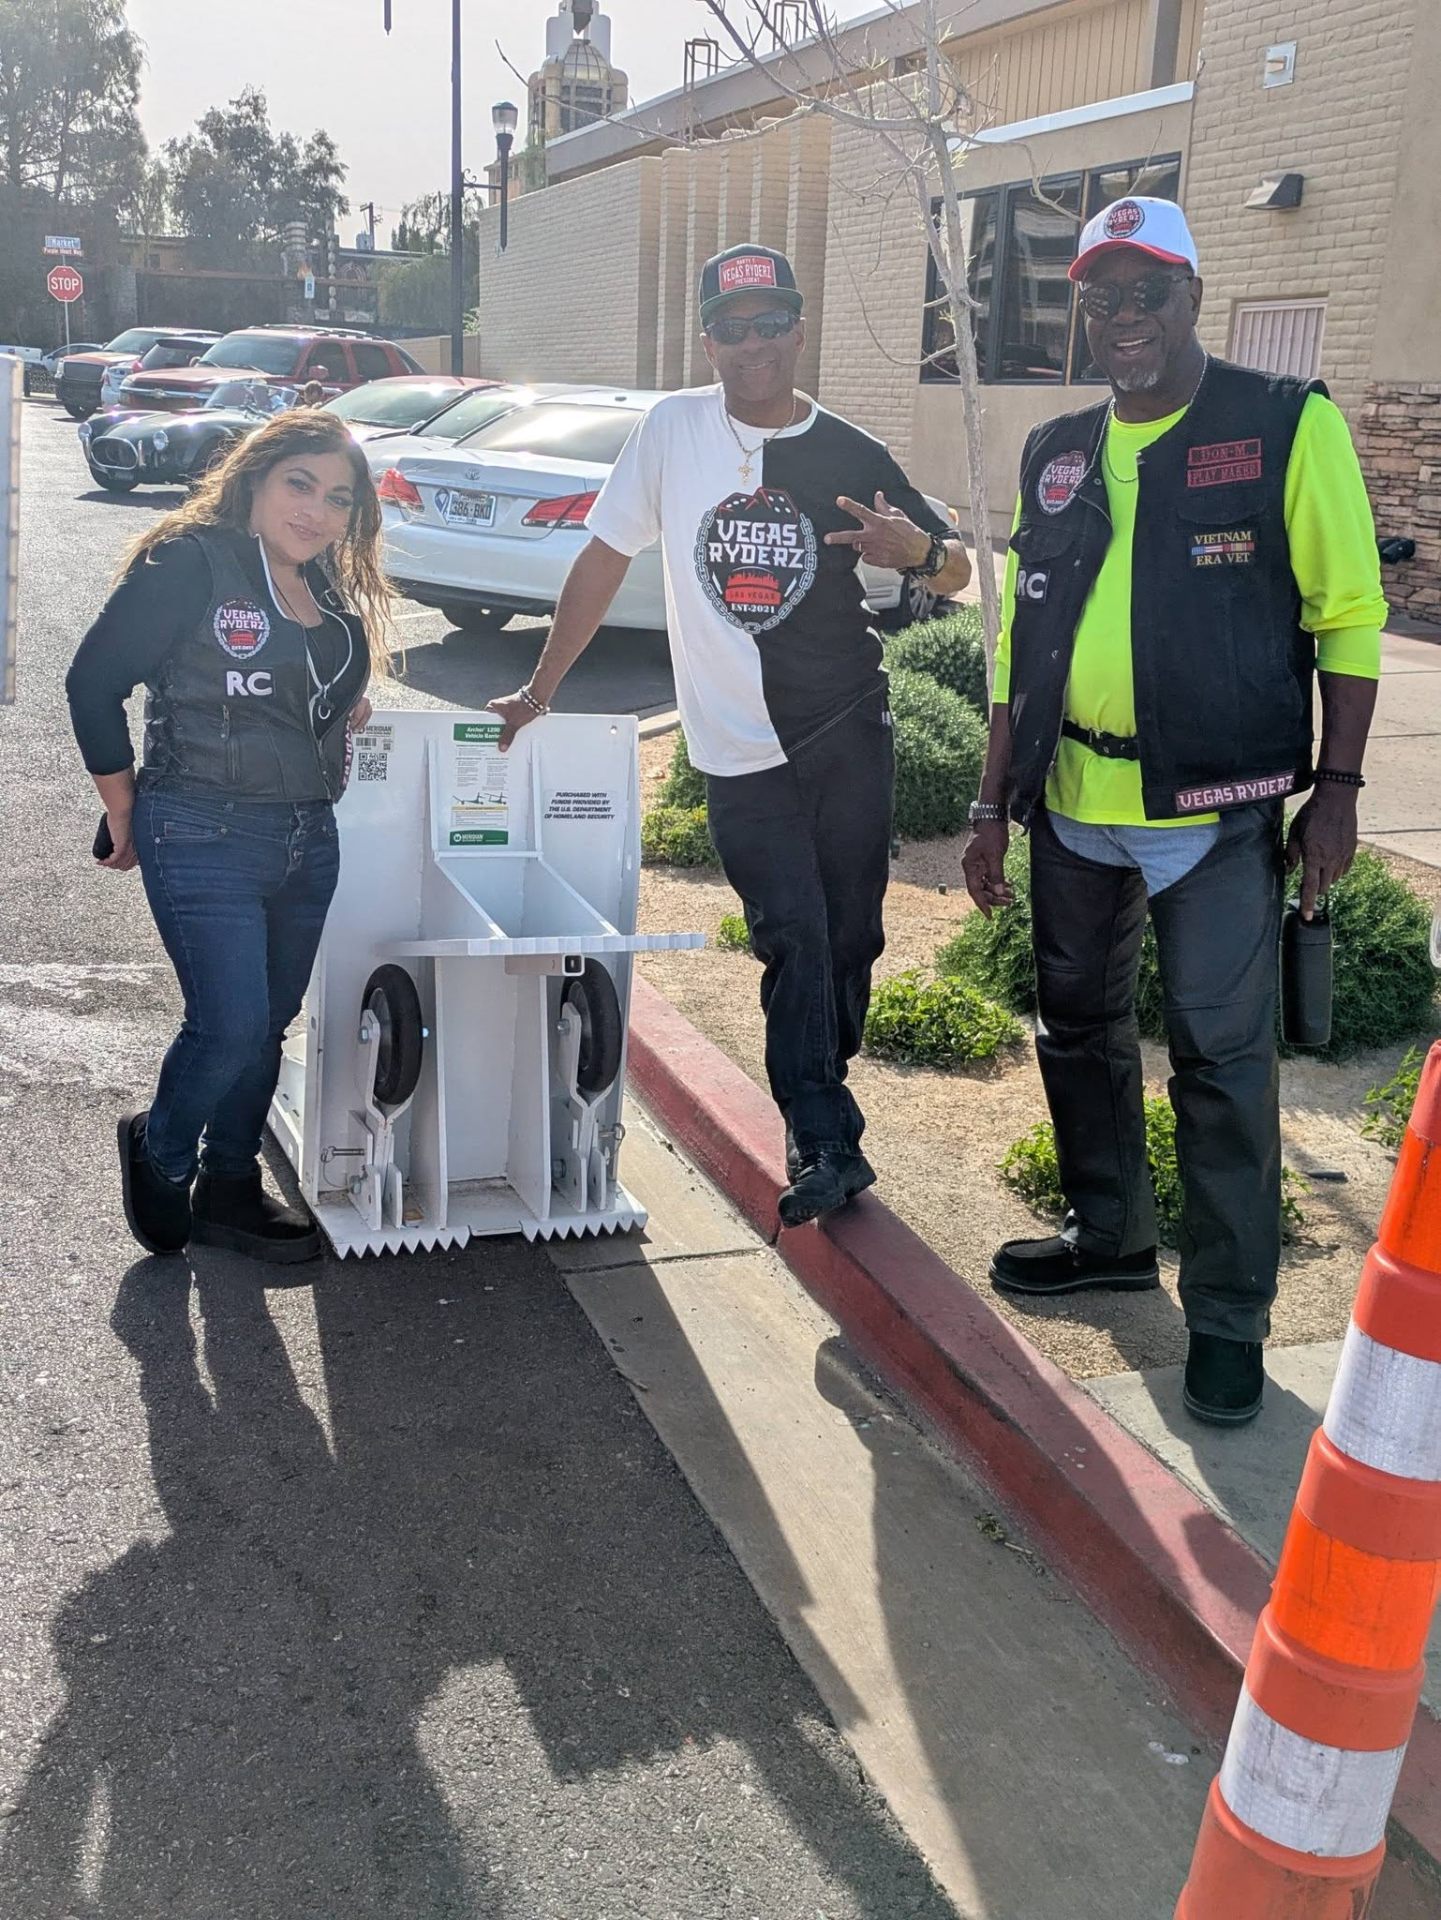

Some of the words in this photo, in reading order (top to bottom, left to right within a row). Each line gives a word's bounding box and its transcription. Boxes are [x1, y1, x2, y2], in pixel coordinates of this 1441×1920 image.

[51, 238, 75, 248] Market
[722, 265, 744, 282] VEGAS
[745, 264, 772, 279] RYDERZ
[51, 277, 79, 291] STOP
[1051, 465, 1081, 476] VEGAS
[1221, 464, 1257, 478] MAKER
[716, 519, 798, 546] VEGAS
[1194, 531, 1252, 545] VIETNAM
[708, 542, 805, 568] RYDERZ
[1196, 554, 1222, 566] ERA
[1226, 552, 1251, 564] VET
[1017, 569, 1047, 599] RC
[748, 591, 775, 600] VEGAS
[223, 609, 261, 620] VEGAS
[220, 619, 265, 630] RYDERZ
[226, 670, 273, 696] RC
[1178, 787, 1233, 808] VEGAS
[1235, 775, 1294, 800] RYDERZ
